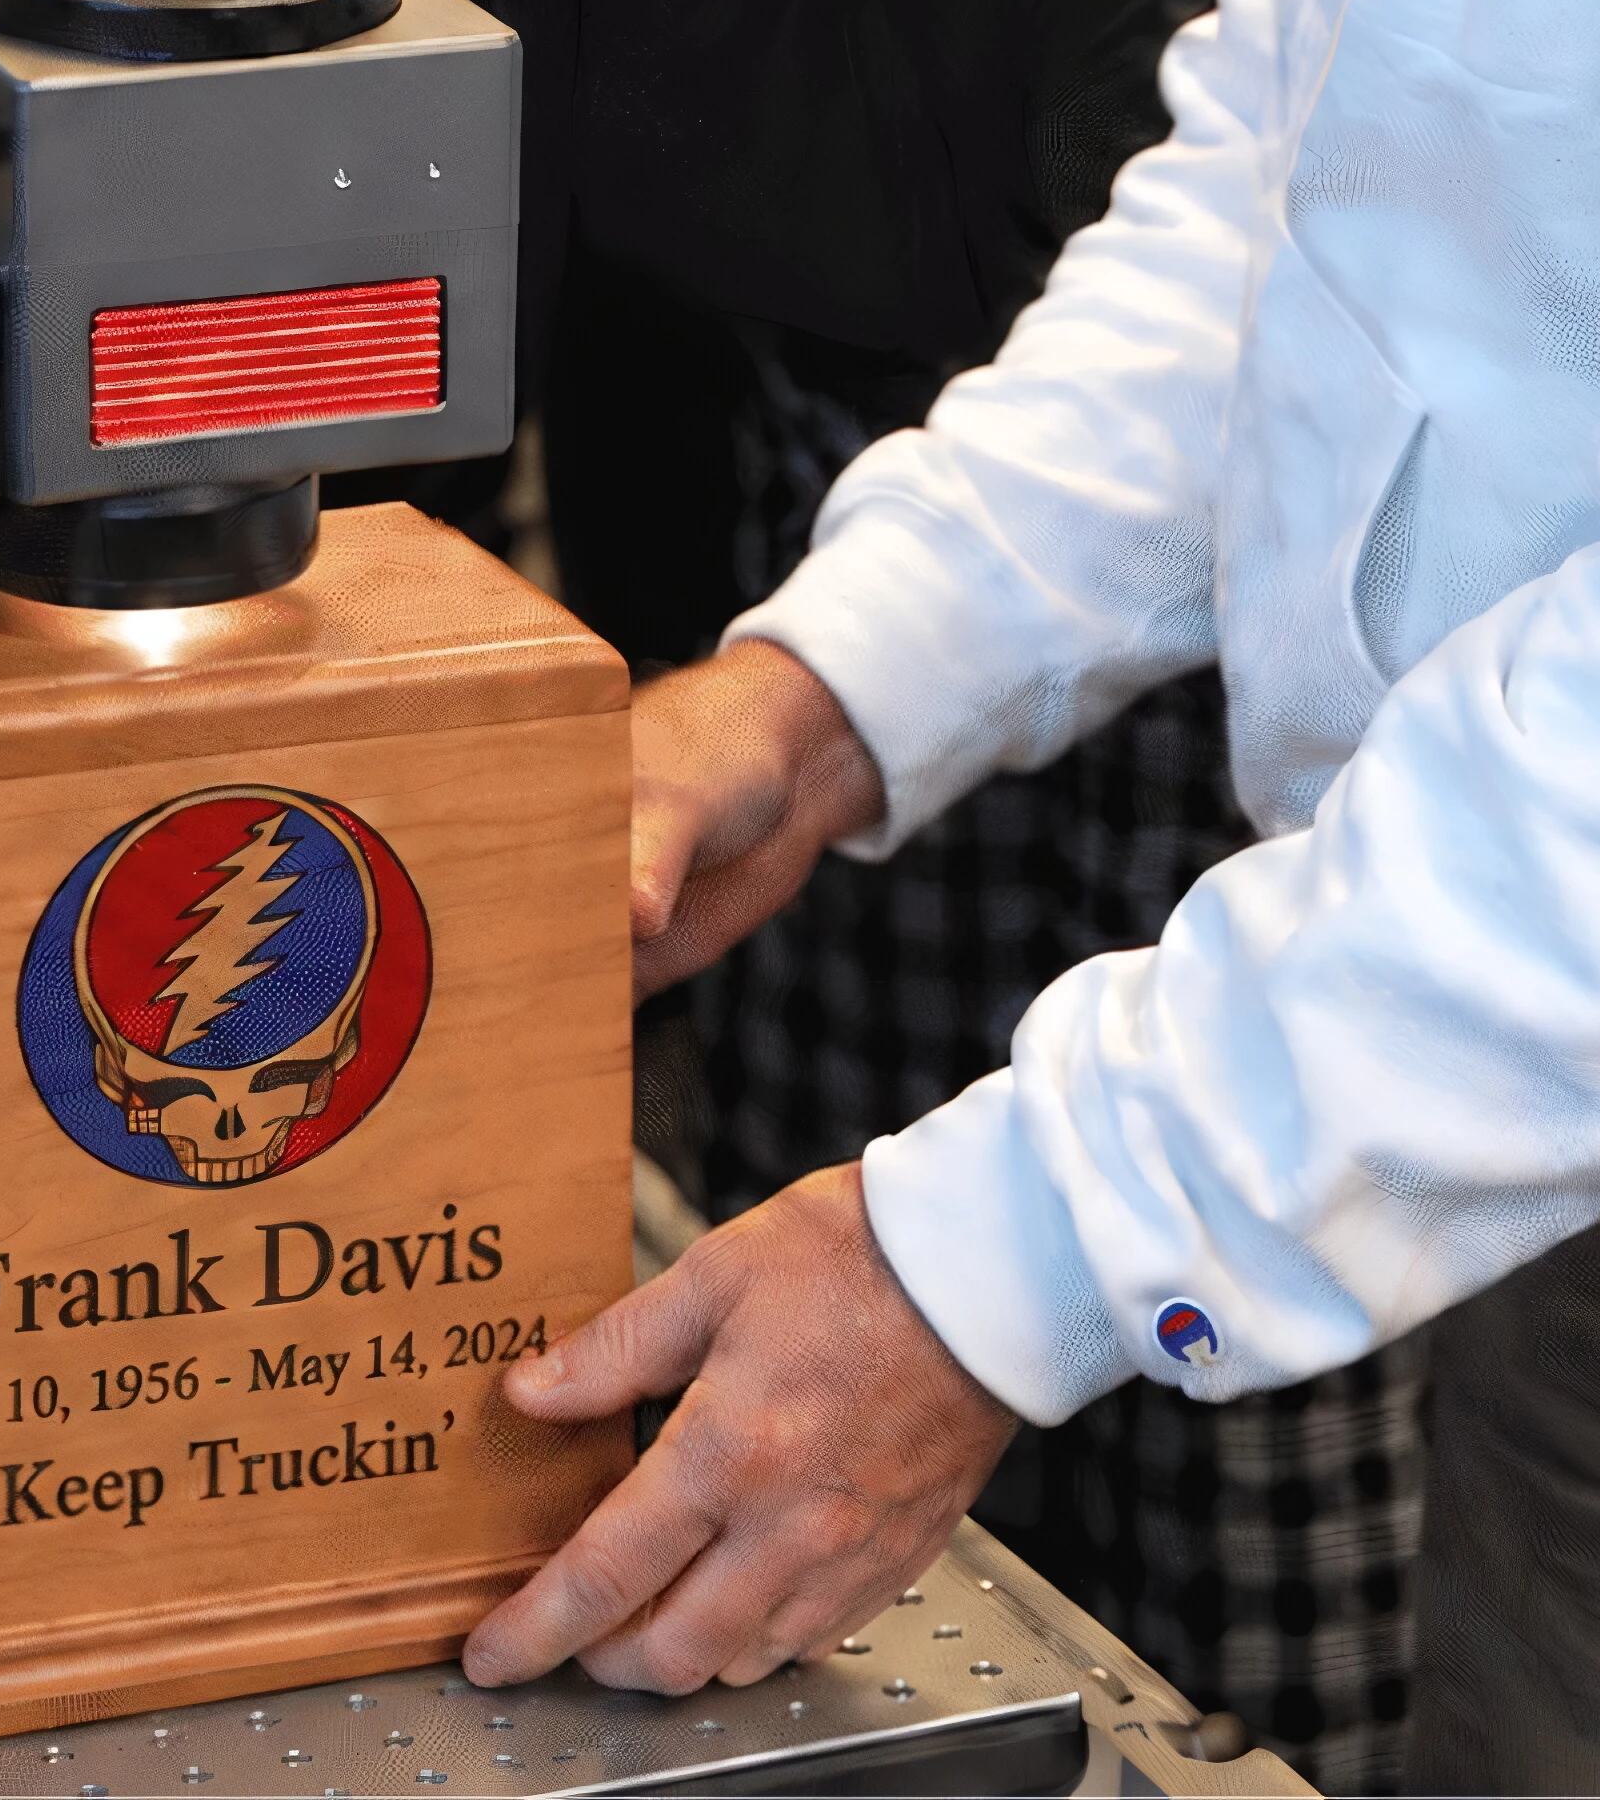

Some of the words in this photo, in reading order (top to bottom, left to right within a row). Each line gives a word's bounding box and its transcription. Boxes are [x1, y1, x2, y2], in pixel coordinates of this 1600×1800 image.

[253, 1204, 504, 1308] Davis
[8, 1376, 72, 1425] 10,
[91, 1357, 200, 1413] 1956
[248, 1344, 352, 1398] May
[366, 1331, 429, 1381] 14,
[444, 1314, 549, 1370] 2024
[0, 1460, 166, 1530] Keep
[189, 1410, 456, 1502] Truckin'
